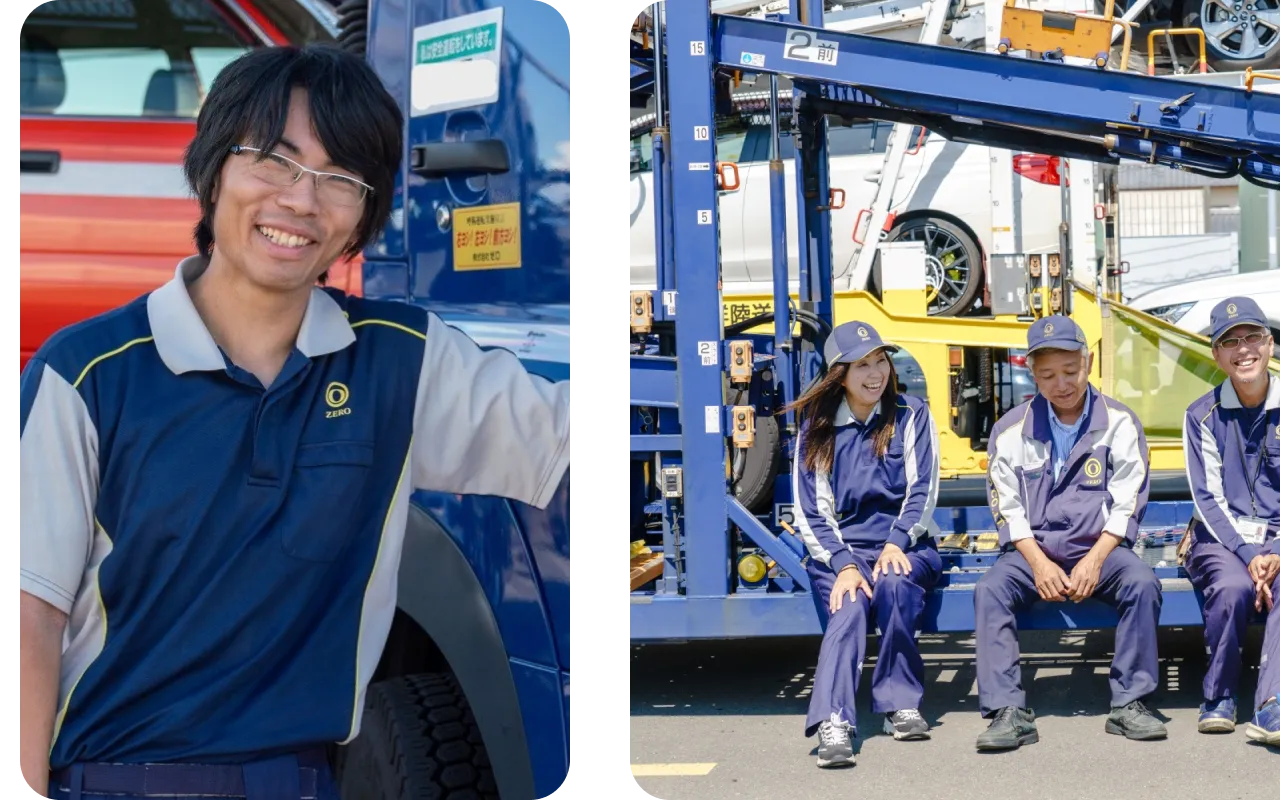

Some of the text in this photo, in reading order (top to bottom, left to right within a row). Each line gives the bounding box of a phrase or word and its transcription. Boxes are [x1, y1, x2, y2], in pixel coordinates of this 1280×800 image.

[692, 43, 704, 54] 15
[696, 127, 707, 139] 10
[702, 212, 708, 223] 5
[325, 407, 351, 418] ZERO
